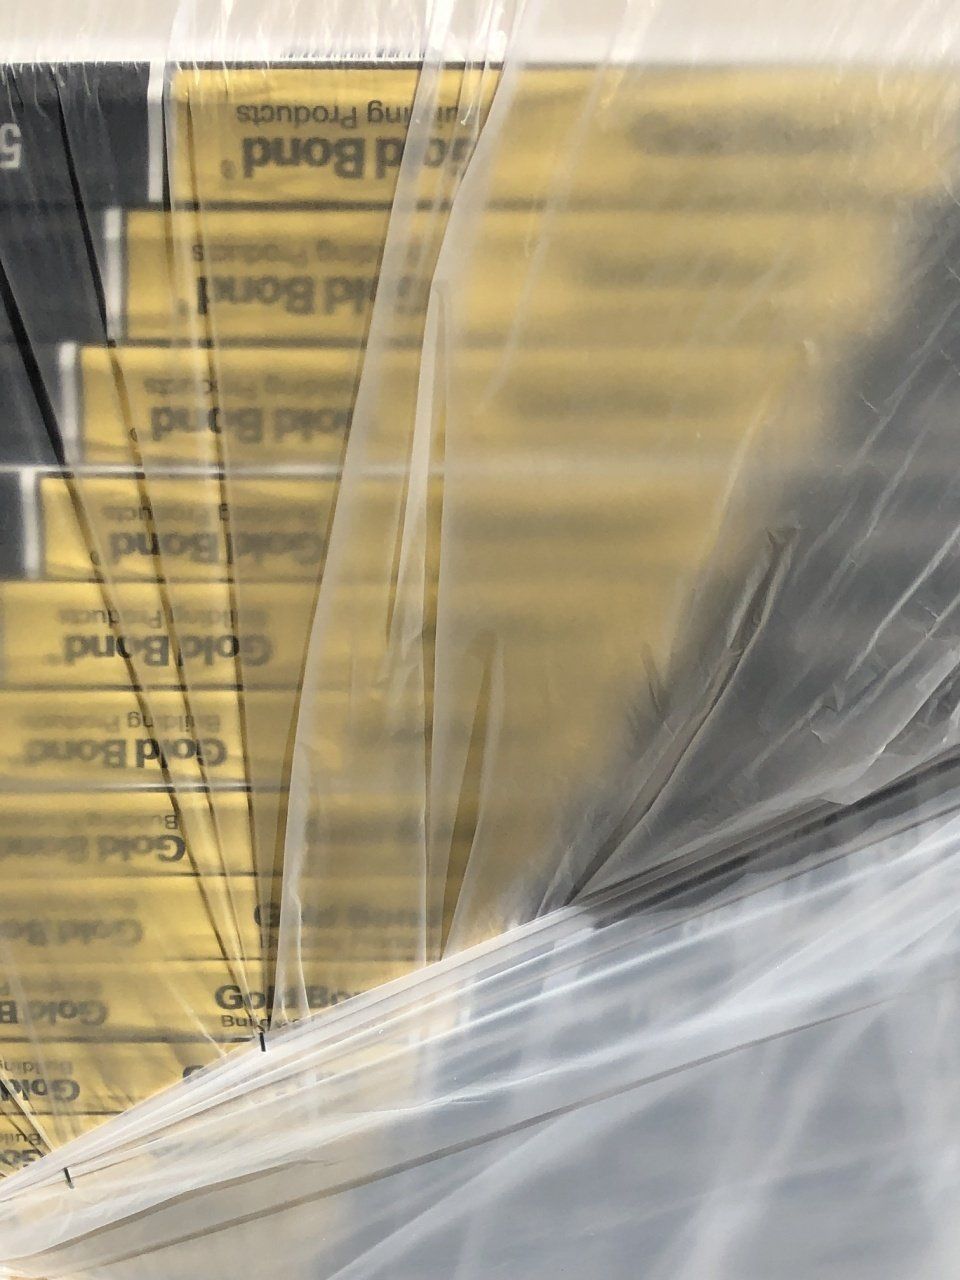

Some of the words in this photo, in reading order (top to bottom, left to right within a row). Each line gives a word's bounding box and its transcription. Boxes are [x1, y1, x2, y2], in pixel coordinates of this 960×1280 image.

[236, 102, 358, 128] Products
[242, 136, 366, 180] Bond
[135, 737, 229, 769] Gold
